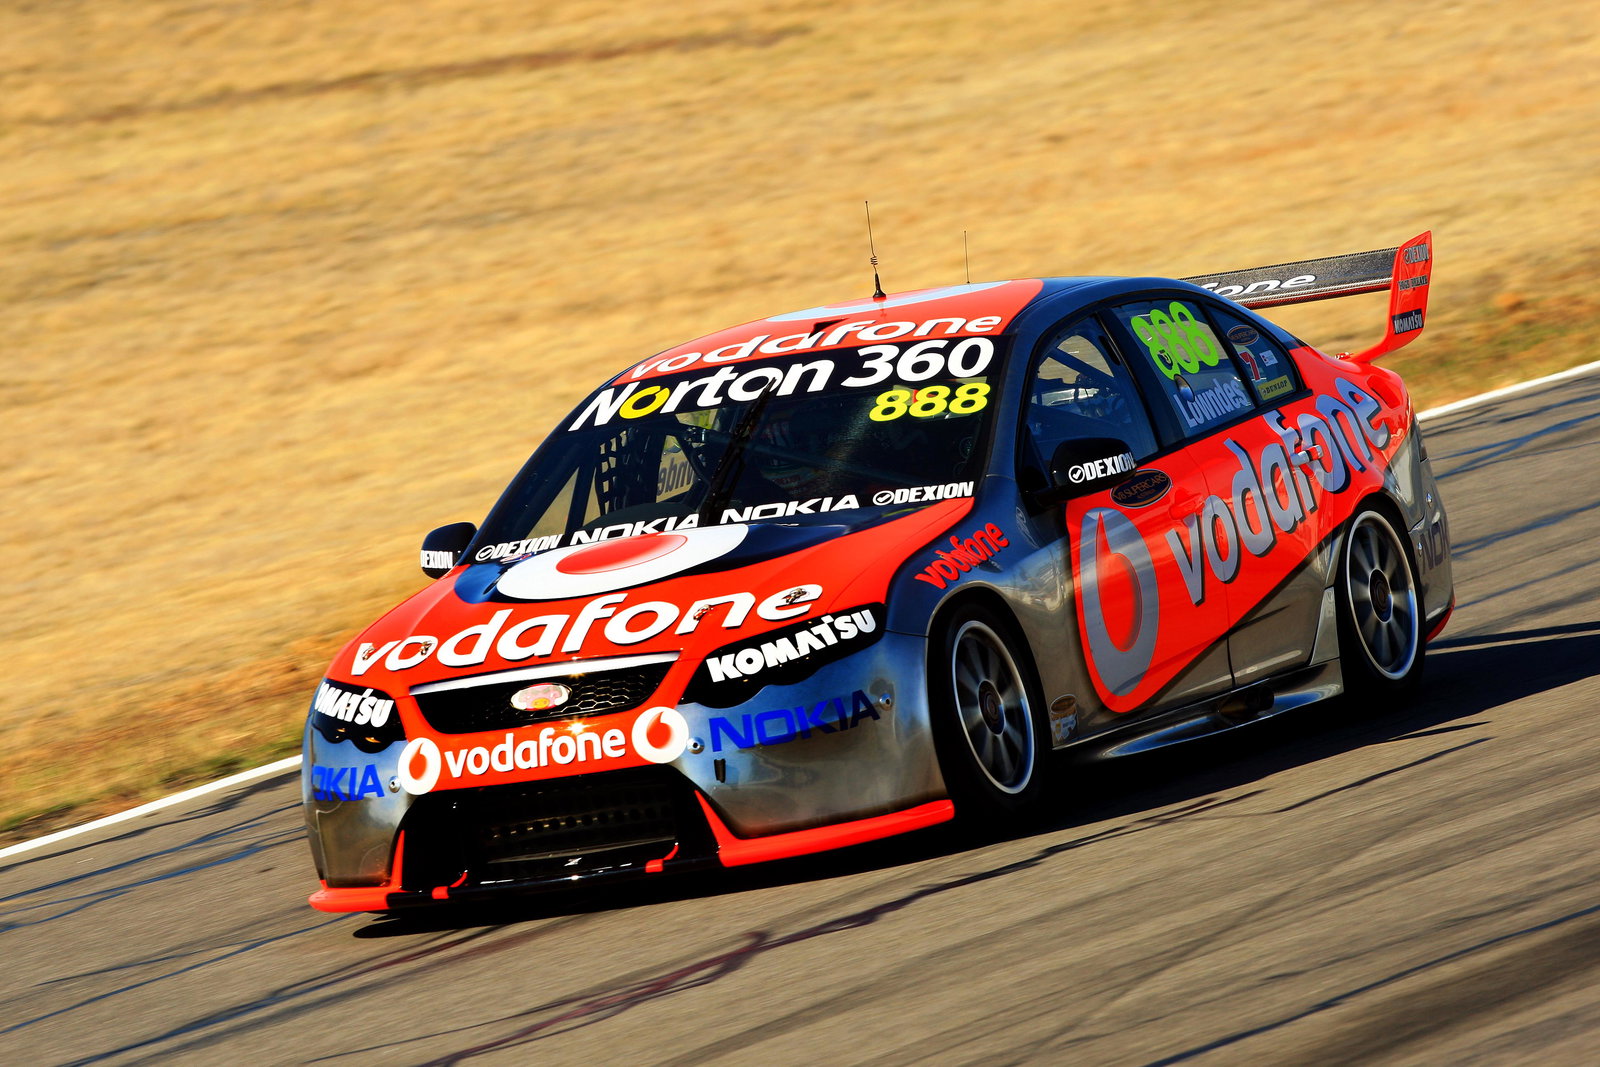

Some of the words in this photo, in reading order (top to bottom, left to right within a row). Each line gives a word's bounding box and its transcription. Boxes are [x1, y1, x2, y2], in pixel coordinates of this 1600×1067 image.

[631, 316, 1002, 379] vodafone
[1131, 301, 1219, 380] 888
[568, 359, 835, 431] Norton
[840, 337, 994, 387] 360
[869, 383, 991, 421] 888
[1173, 379, 1248, 428] Lowndes
[1265, 379, 1288, 395] DUNLOP
[1083, 452, 1137, 481] DEXION
[1164, 377, 1390, 607] vodafone
[490, 534, 563, 560] DEXION
[569, 514, 700, 546] NOKIA
[720, 495, 860, 525] NOKIA
[892, 481, 974, 505] DEXION
[420, 549, 453, 569] DEXION
[914, 523, 1009, 590] vodafone
[350, 584, 824, 676] vodafone
[706, 609, 877, 683] KOMATSU
[444, 727, 626, 779] vodafone
[708, 689, 881, 753] NOKIA
